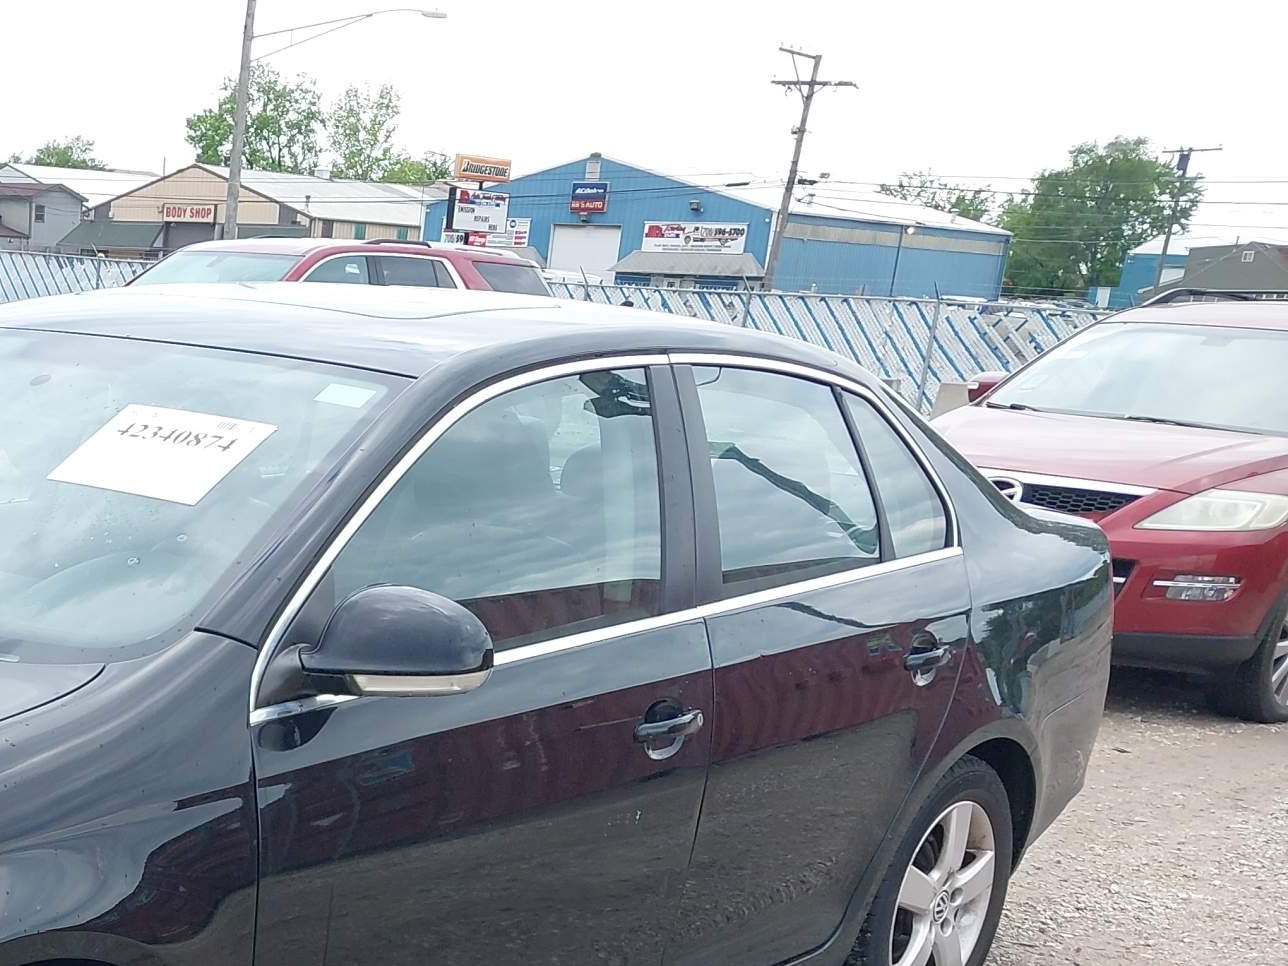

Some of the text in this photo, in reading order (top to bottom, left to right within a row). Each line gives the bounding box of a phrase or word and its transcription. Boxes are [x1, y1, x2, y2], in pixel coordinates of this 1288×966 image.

[462, 161, 509, 177] BRIDGESTONE
[165, 206, 212, 219] BODY SHOP
[117, 422, 237, 452] 42340874
